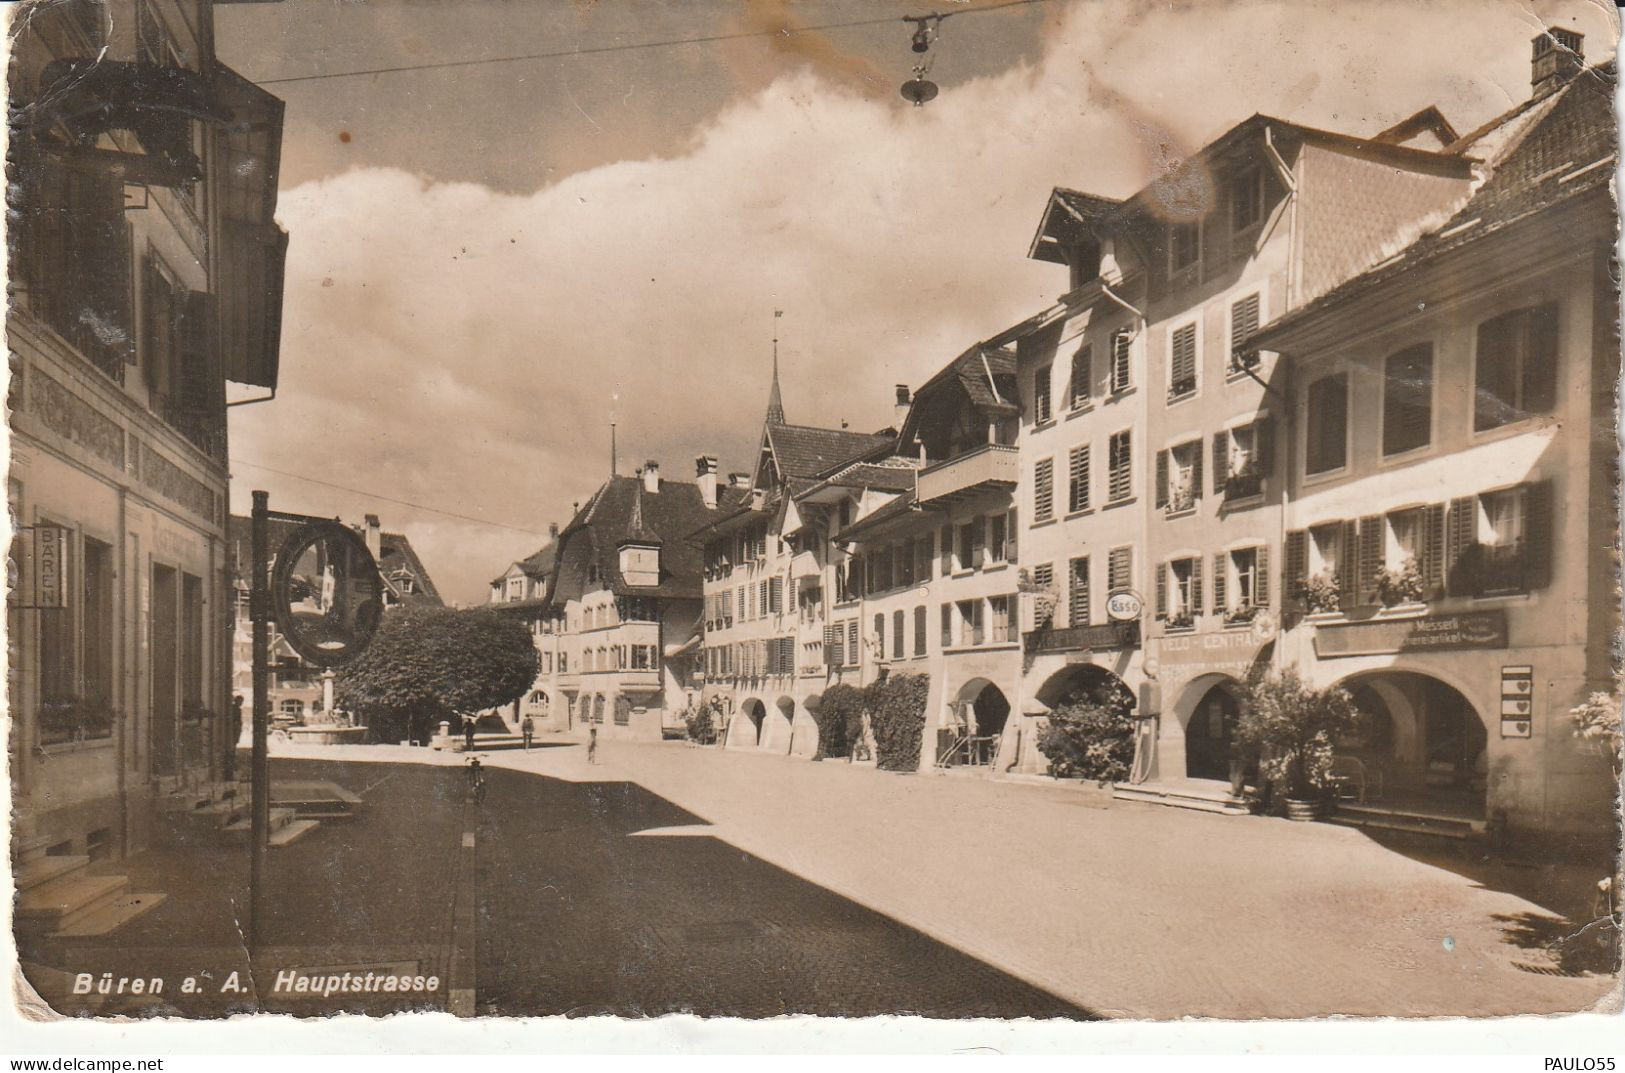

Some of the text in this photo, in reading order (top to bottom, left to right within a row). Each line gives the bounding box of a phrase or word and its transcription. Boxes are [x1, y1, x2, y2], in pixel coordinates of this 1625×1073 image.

[42, 530, 54, 603] BÄREN
[1112, 600, 1139, 612] Esso
[1160, 637, 1190, 651] VELO
